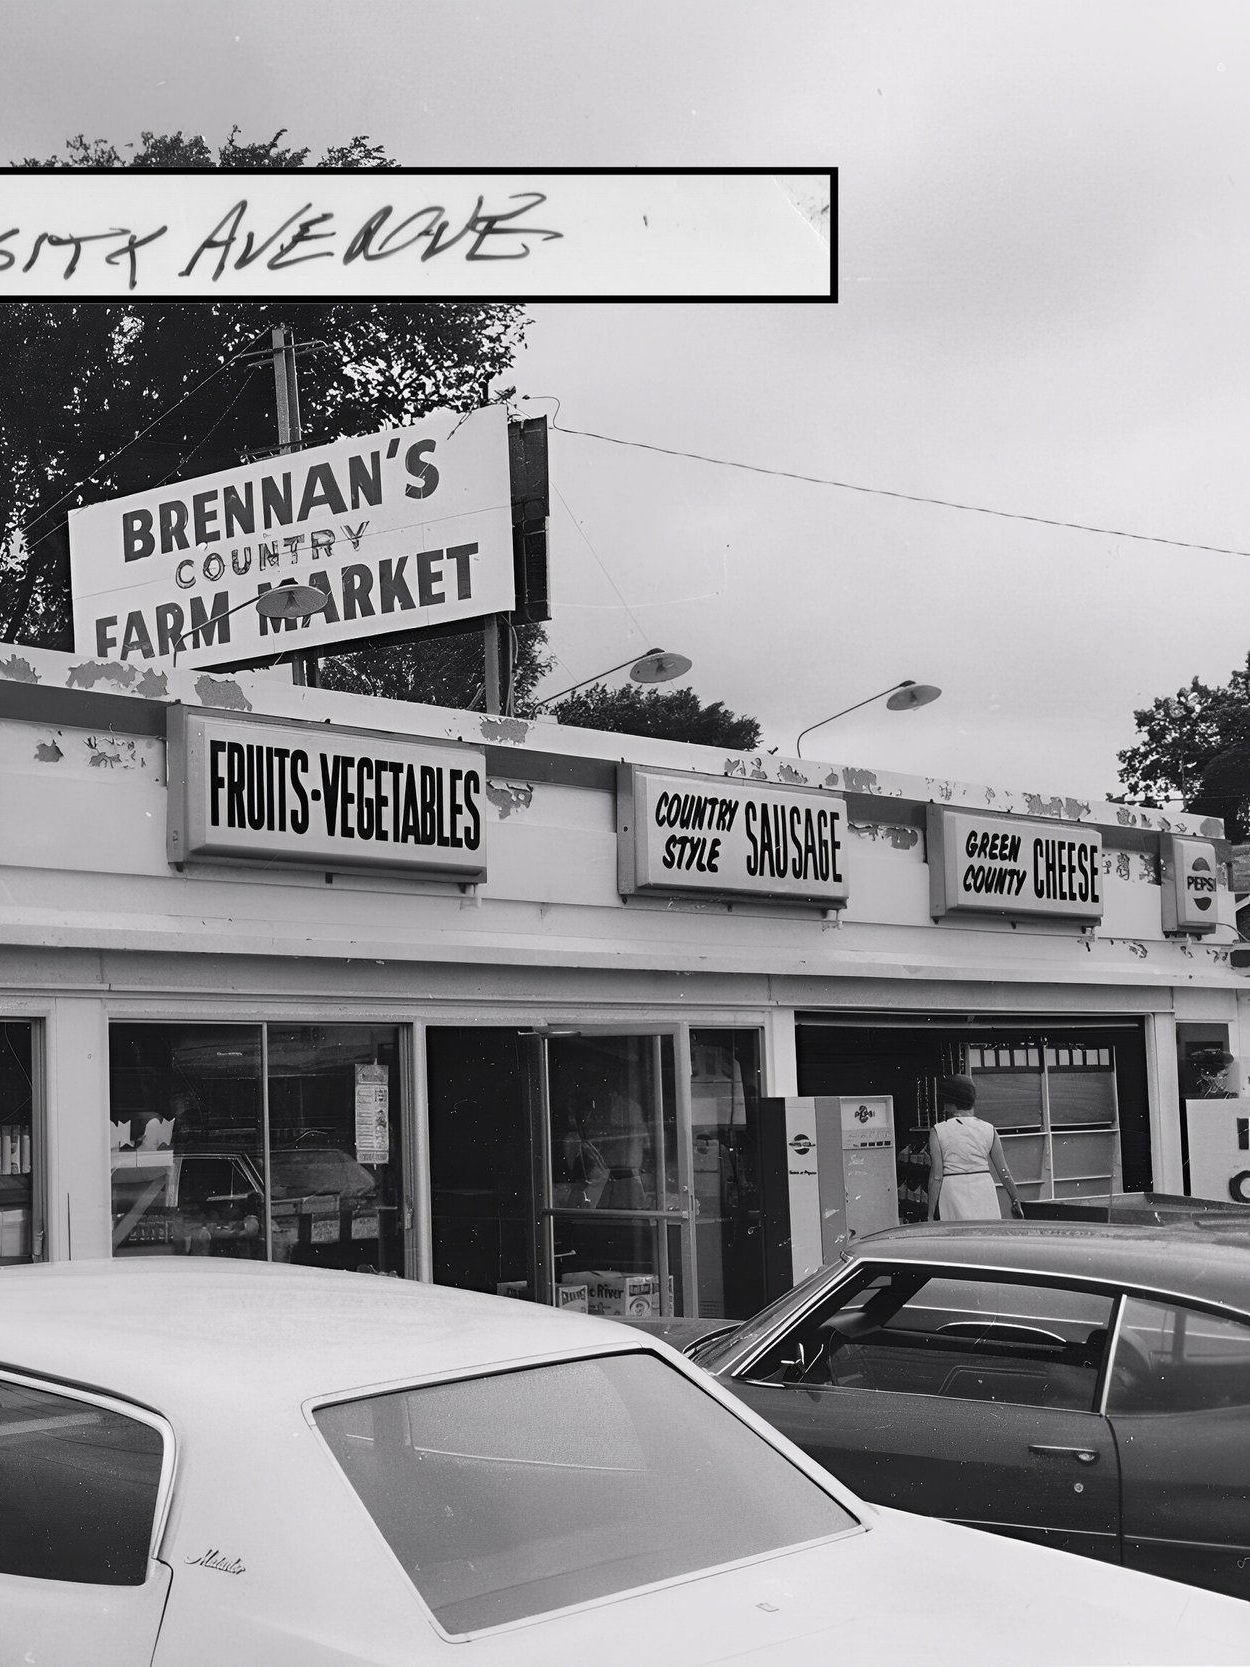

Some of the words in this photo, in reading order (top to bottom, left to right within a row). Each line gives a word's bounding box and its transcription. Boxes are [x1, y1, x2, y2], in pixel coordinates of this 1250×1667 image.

[122, 436, 440, 563] BRENNAN'S
[175, 520, 370, 590] COUNTRY
[95, 590, 231, 661] FARM
[655, 791, 739, 832] COUNTRY
[745, 801, 843, 883] SAUSAGE
[662, 834, 722, 873] STYLE
[965, 830, 1021, 863] GREEN
[1033, 838, 1100, 903] CHEESE
[963, 864, 1027, 896] COUNTY
